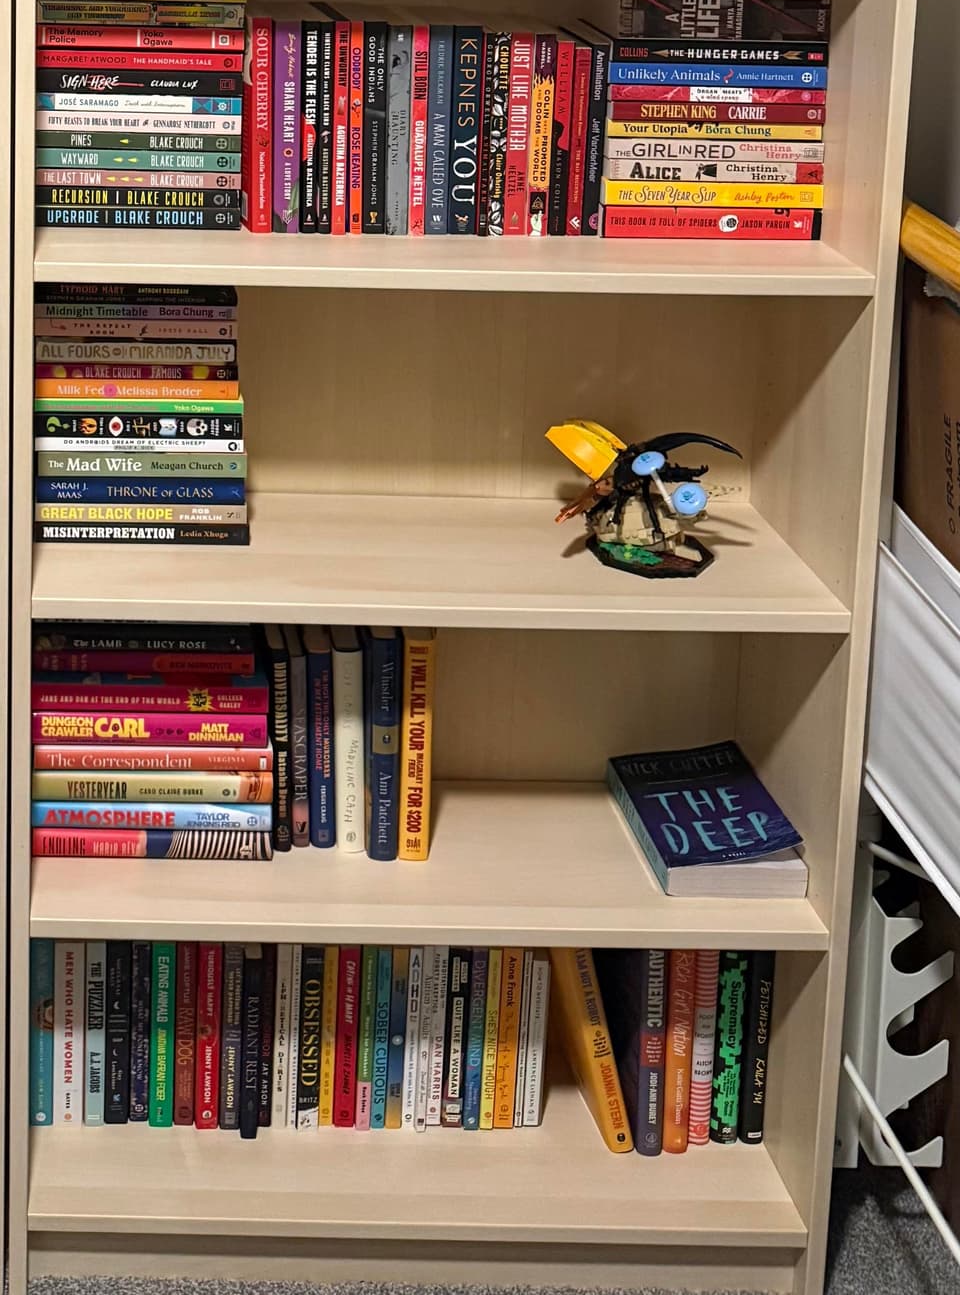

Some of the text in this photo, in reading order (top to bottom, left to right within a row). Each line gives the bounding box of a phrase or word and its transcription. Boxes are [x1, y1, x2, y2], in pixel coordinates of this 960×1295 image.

[687, 48, 737, 59] HUNGER
[741, 50, 779, 60] GAMES
[255, 28, 268, 131] SOUR CHERRY
[618, 68, 721, 83] Unlikely Animals
[641, 105, 766, 119] STEPHEN KING CARRIE
[451, 38, 478, 205] KEPNES YOU
[52, 190, 204, 206] RECURSION BLAKE CROUCH
[47, 210, 203, 225] UPGRADE BLAKE CROUCH
[49, 458, 142, 472] The Mad Wife
[944, 414, 954, 510] FRAGILE
[107, 486, 158, 497] THRONE
[176, 487, 214, 498] GLASS
[41, 508, 173, 519] GREAT BLACK HOPE
[43, 527, 175, 539] MISINTERPRETATION
[94, 717, 150, 738] CARL
[200, 724, 229, 733] MATT
[188, 732, 244, 742] DINNIMAN
[47, 754, 192, 770] The Correspondent
[67, 782, 127, 799] YESTERYEAR
[643, 787, 743, 822] THE
[44, 810, 176, 828] ATMOSPHERE
[661, 812, 769, 854] DEEP
[64, 951, 74, 1084] MEN WHO HATE WOMEN
[727, 977, 742, 1051] Supremacy
[302, 979, 322, 1088] OBSESSED
